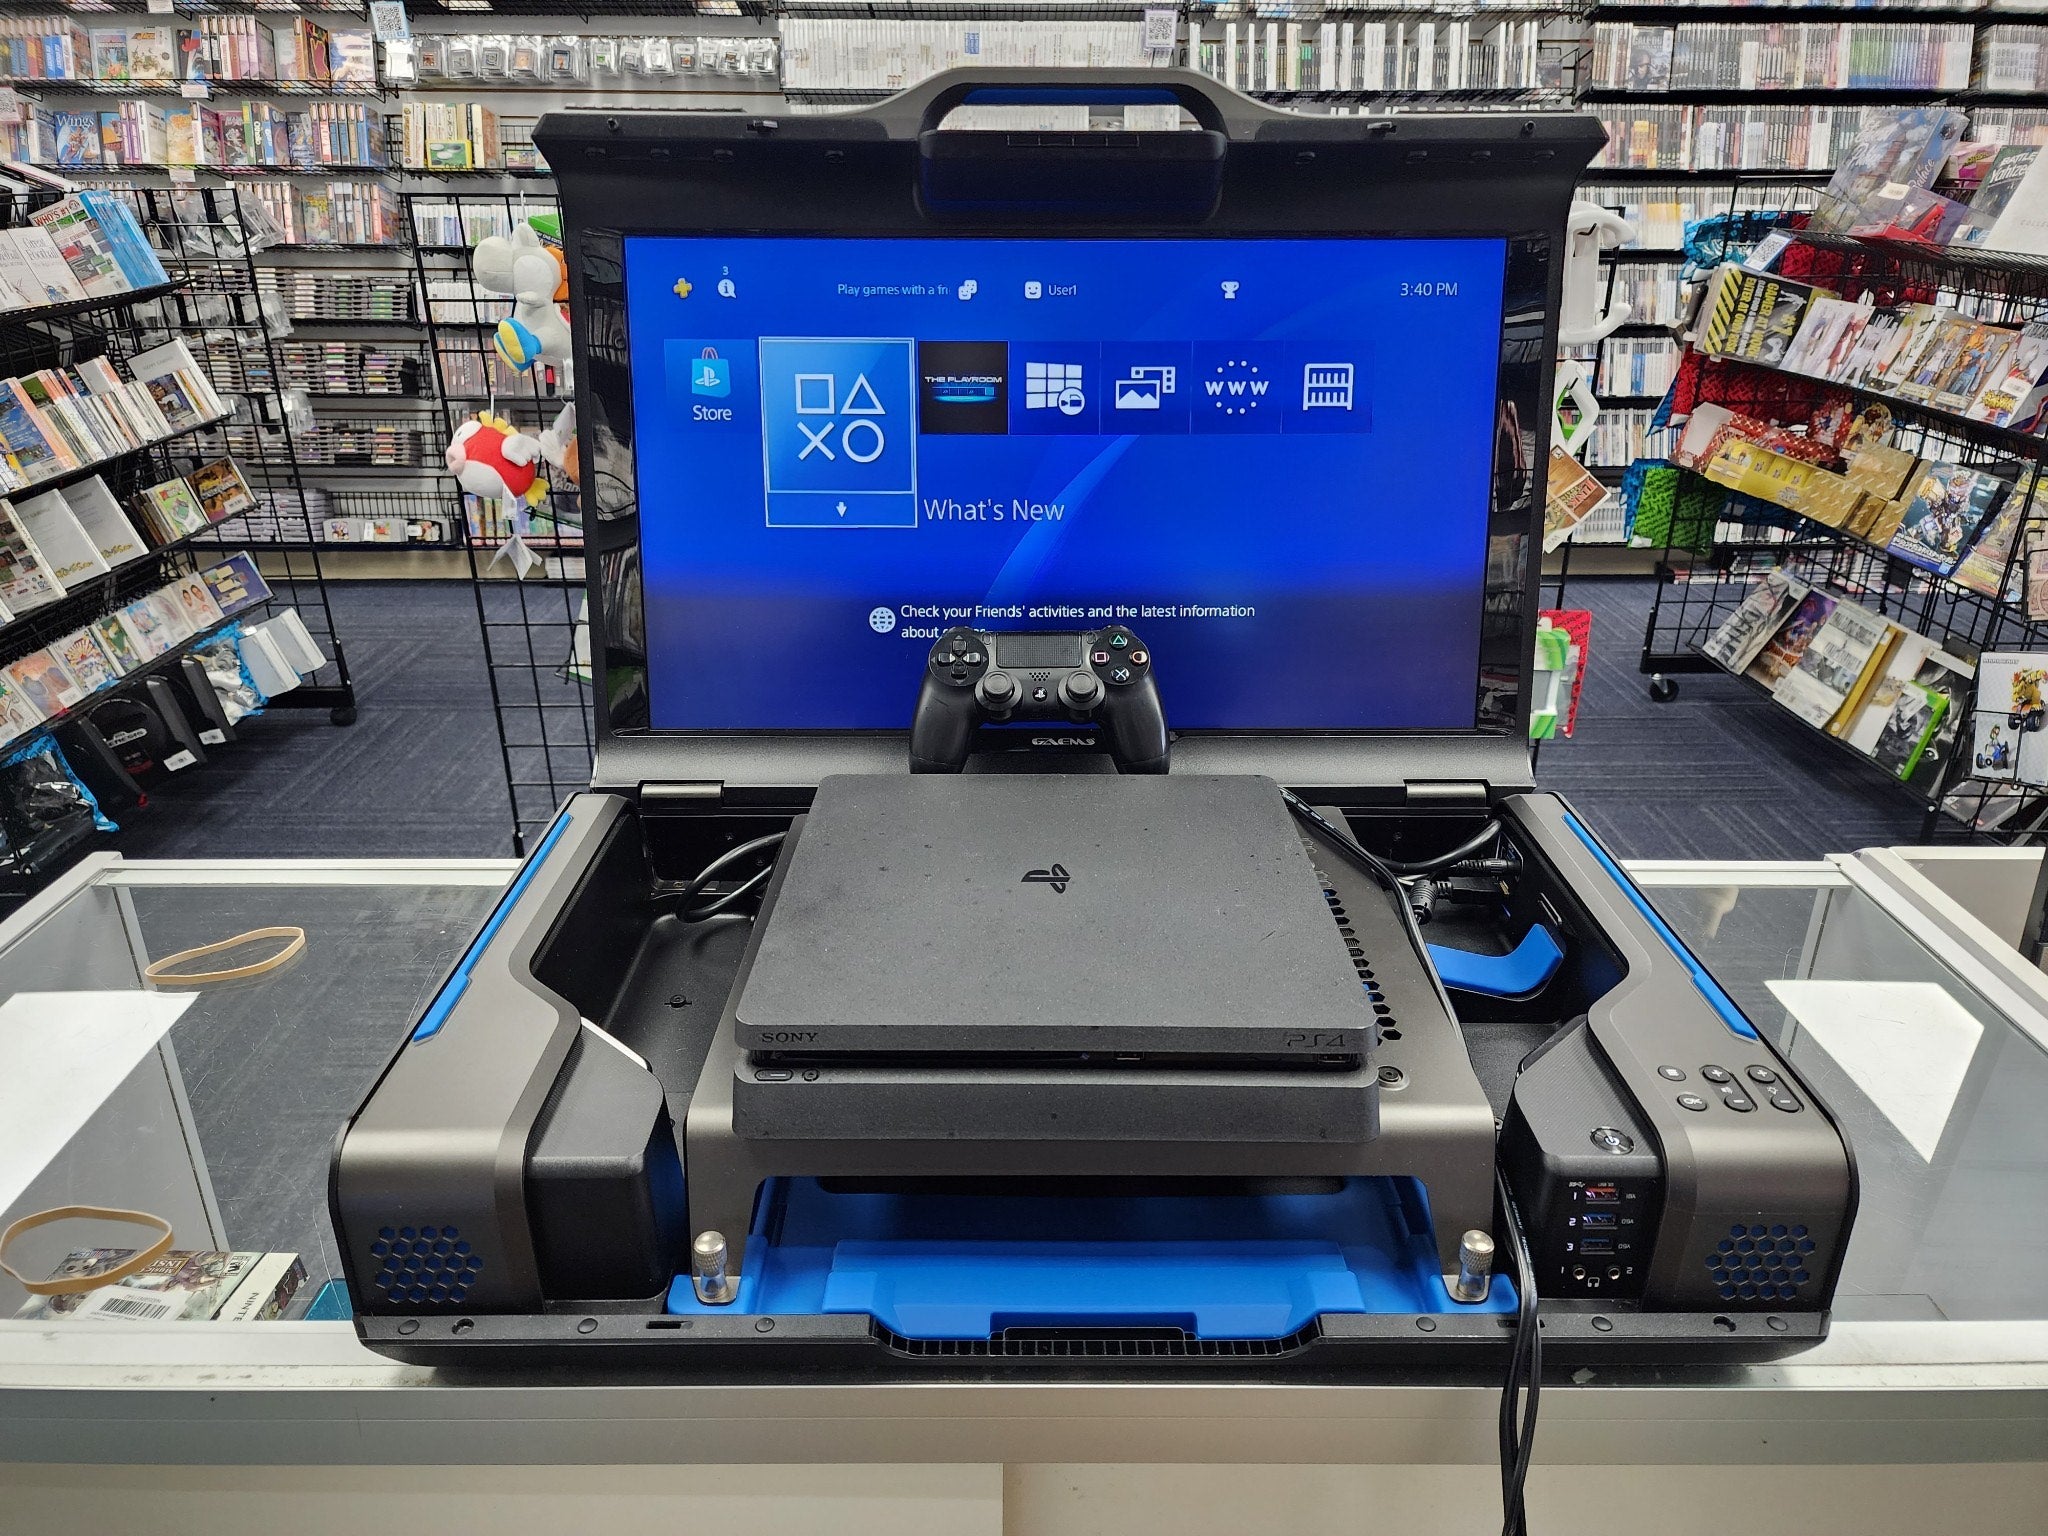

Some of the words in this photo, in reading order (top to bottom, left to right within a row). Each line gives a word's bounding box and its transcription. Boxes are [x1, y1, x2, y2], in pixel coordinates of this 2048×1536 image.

[56, 115, 95, 129] Wings
[1990, 164, 2029, 184] Yahtze
[34, 211, 60, 227] WHO'S
[60, 206, 71, 217] #1
[22, 237, 46, 249] Great
[26, 246, 59, 261] Football
[722, 266, 729, 276] 3
[838, 283, 860, 296] Play
[863, 286, 900, 297] games
[902, 283, 925, 295] with
[928, 286, 935, 295] a
[1048, 283, 1077, 296] User1
[1400, 282, 1433, 296] 3:40
[1436, 282, 1458, 296] PM
[1739, 277, 1757, 303] ENTER
[1758, 282, 1780, 317] GAMER
[1737, 301, 1749, 313] AT
[1755, 315, 1769, 329] AT
[1745, 328, 1766, 358] WORK
[692, 405, 732, 421] Store
[924, 499, 1004, 521] What's
[1012, 499, 1065, 521] New
[900, 605, 939, 618] Check
[942, 607, 973, 621] your
[975, 605, 1025, 618] Friends'
[1029, 605, 1085, 618] activities
[1087, 605, 1113, 618] and
[1116, 605, 1137, 618] the
[1141, 605, 1176, 618] latest
[1179, 604, 1256, 618] information
[901, 626, 939, 639] about
[1031, 738, 1096, 746] GAEMS
[761, 1032, 818, 1043] SONY
[1283, 1034, 1346, 1048] PS4
[1573, 1192, 1578, 1200] 1
[1569, 1218, 1577, 1226] 2
[1566, 1242, 1574, 1251] 3
[1626, 1266, 1633, 1274] 2
